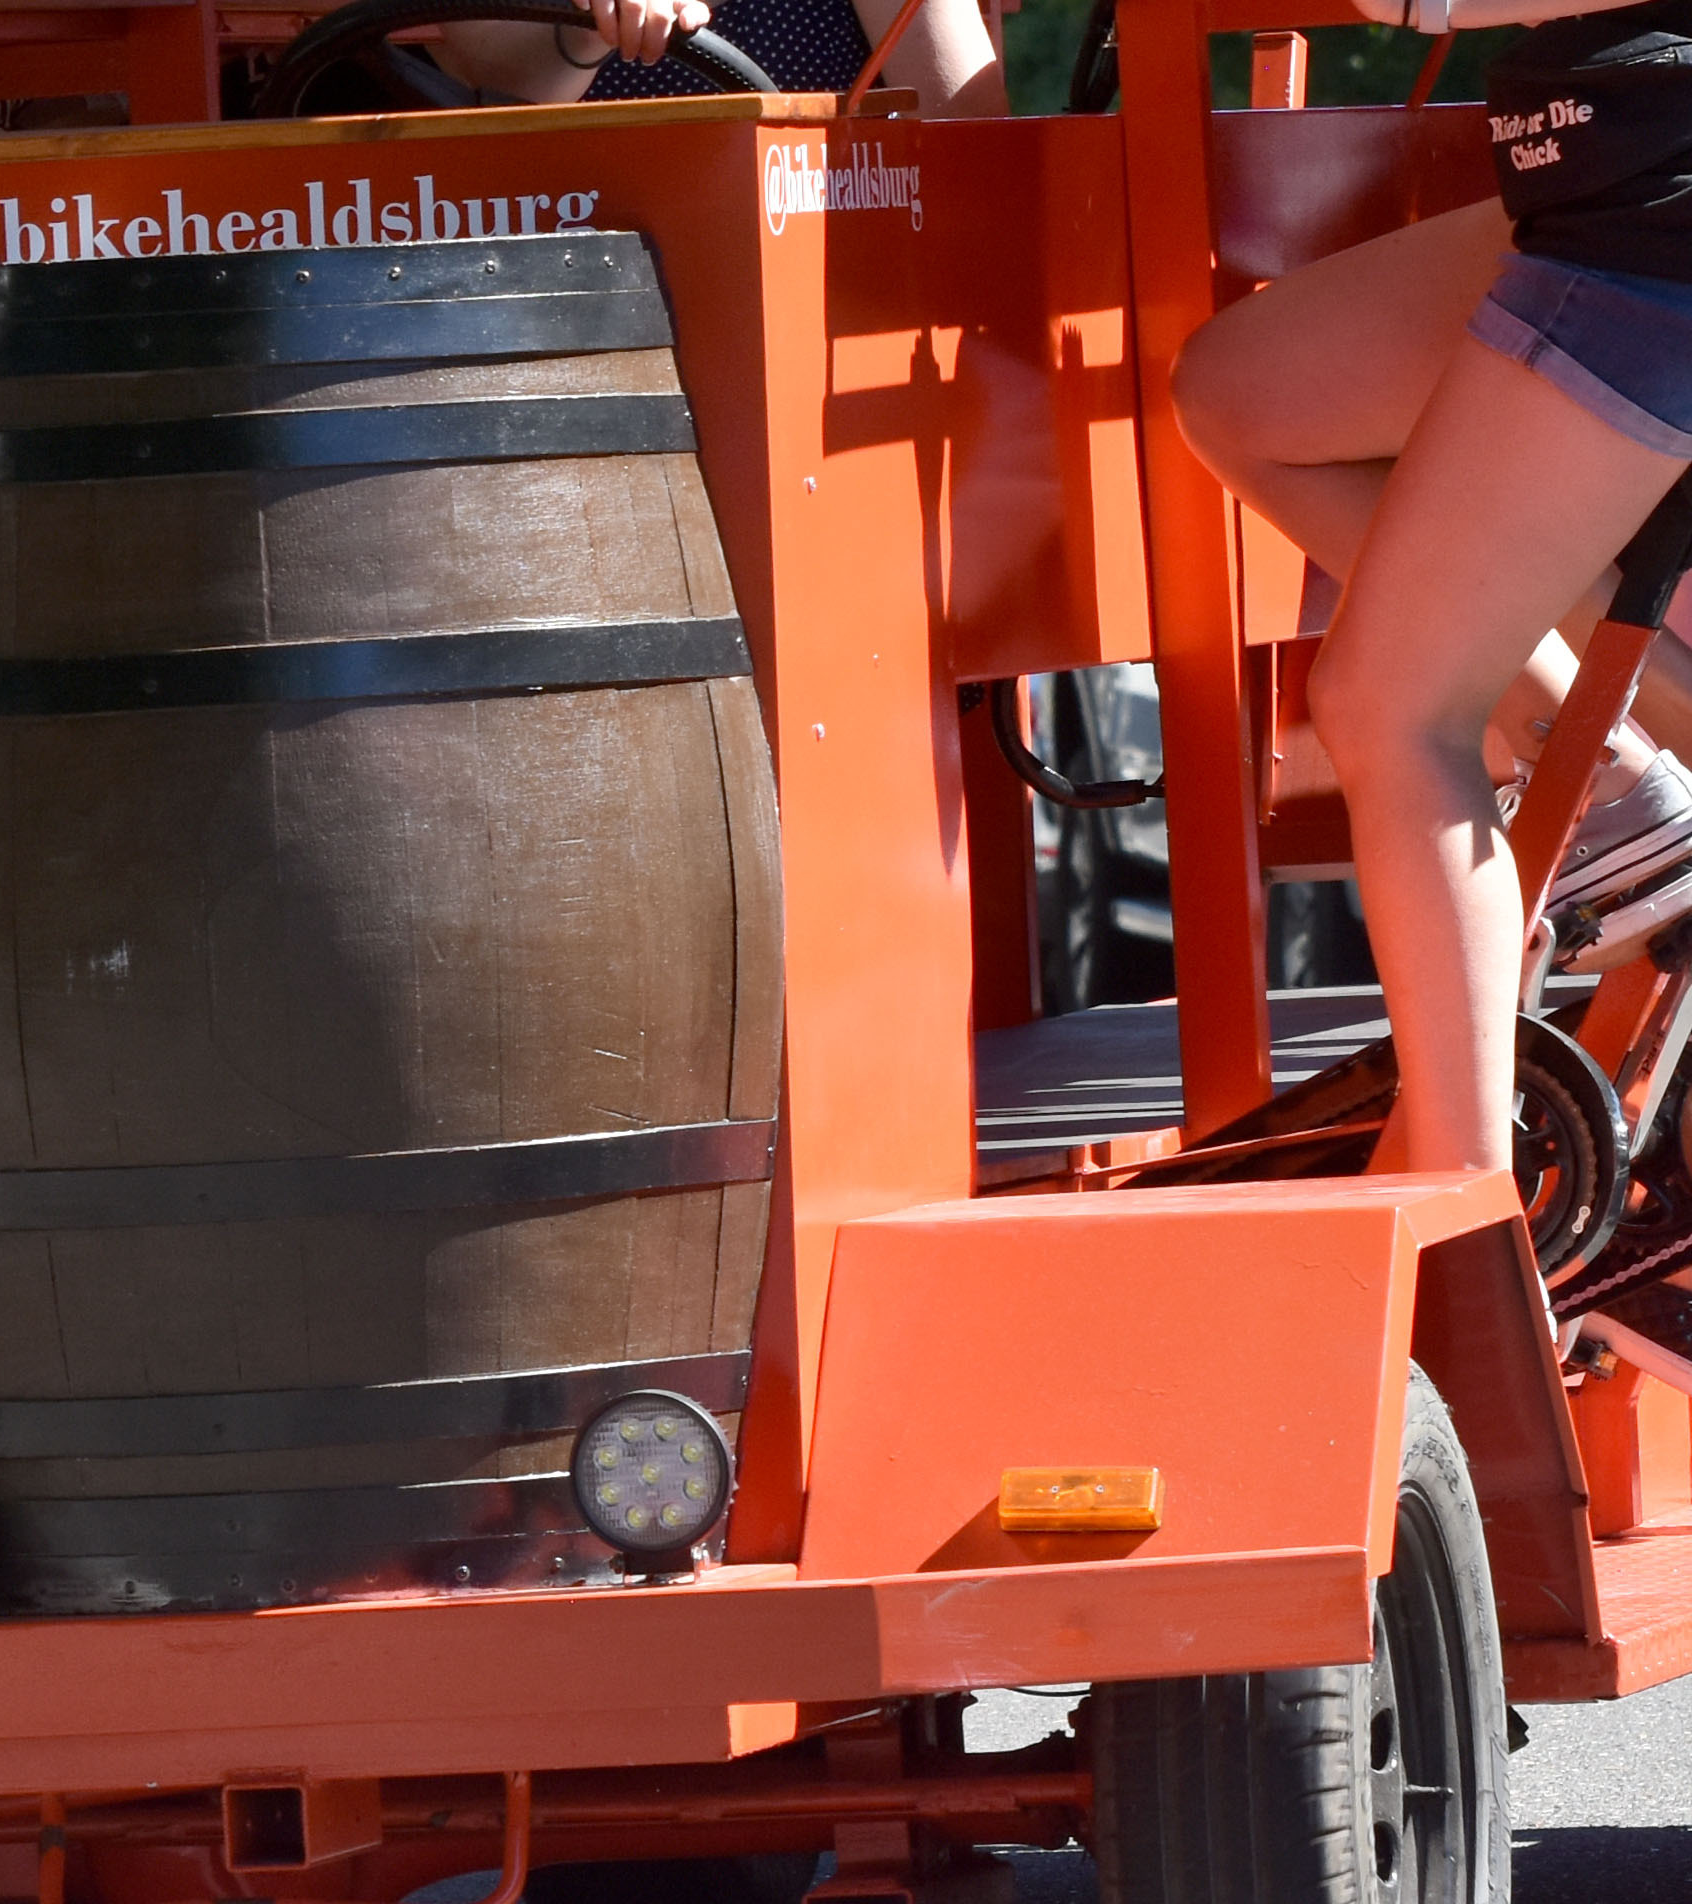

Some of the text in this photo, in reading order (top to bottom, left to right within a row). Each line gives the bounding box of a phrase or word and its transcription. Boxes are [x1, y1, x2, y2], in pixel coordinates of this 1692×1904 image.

[1488, 99, 1593, 143] Ride or Die
[1511, 137, 1560, 171] Chick
[764, 142, 923, 235] @bikehealdsburg
